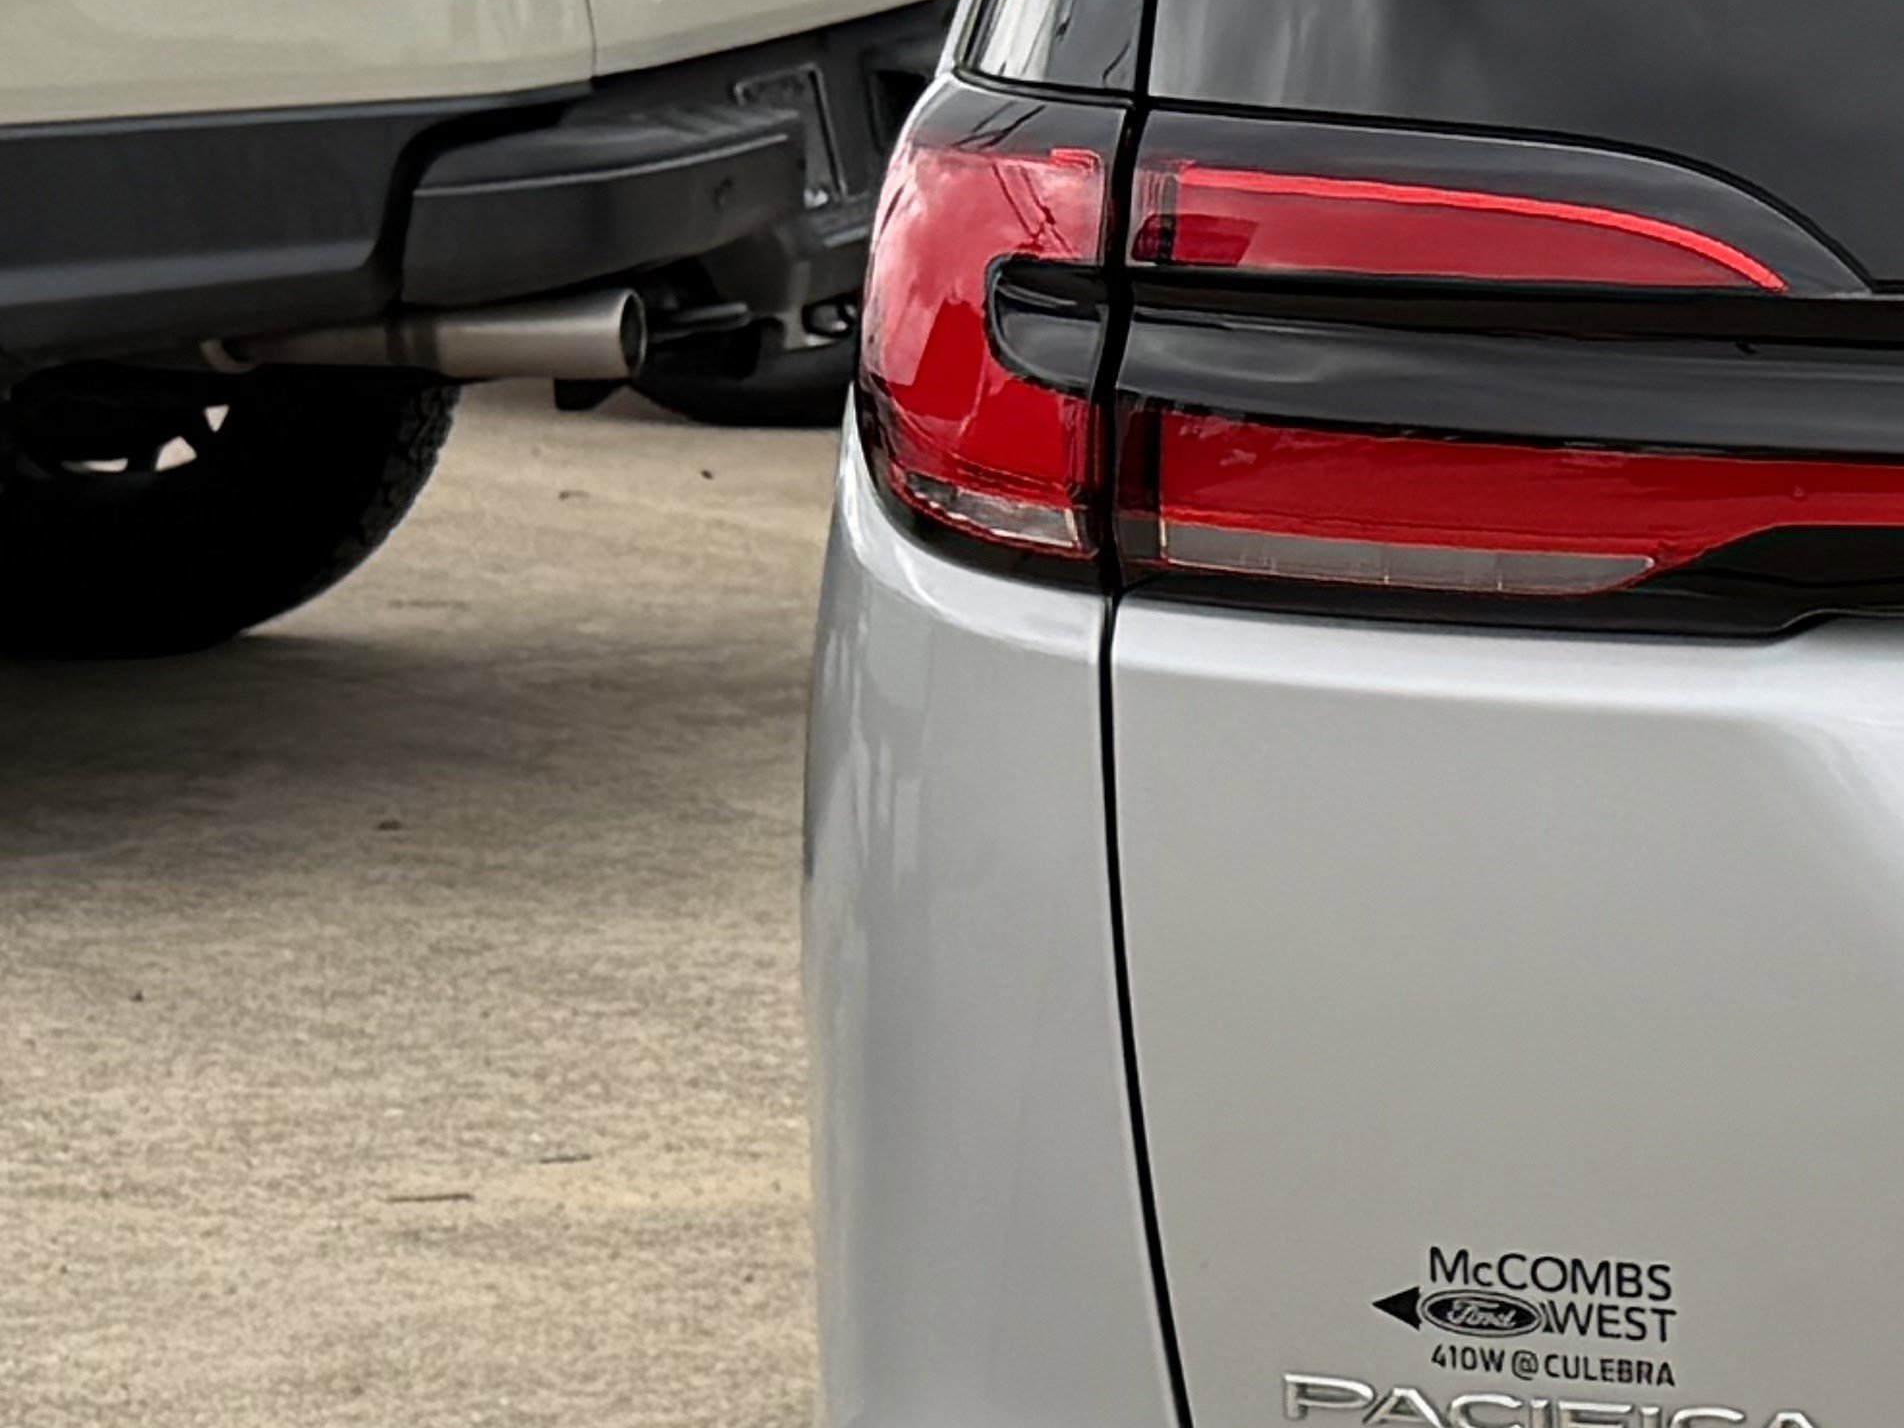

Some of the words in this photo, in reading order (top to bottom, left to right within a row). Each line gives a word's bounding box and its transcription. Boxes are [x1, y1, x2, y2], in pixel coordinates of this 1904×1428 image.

[1429, 1246, 1672, 1302] McCOMBS
[1546, 1302, 1677, 1344] WEST
[1431, 1343, 1506, 1375] 410W
[1544, 1353, 1676, 1388] CULEBRA
